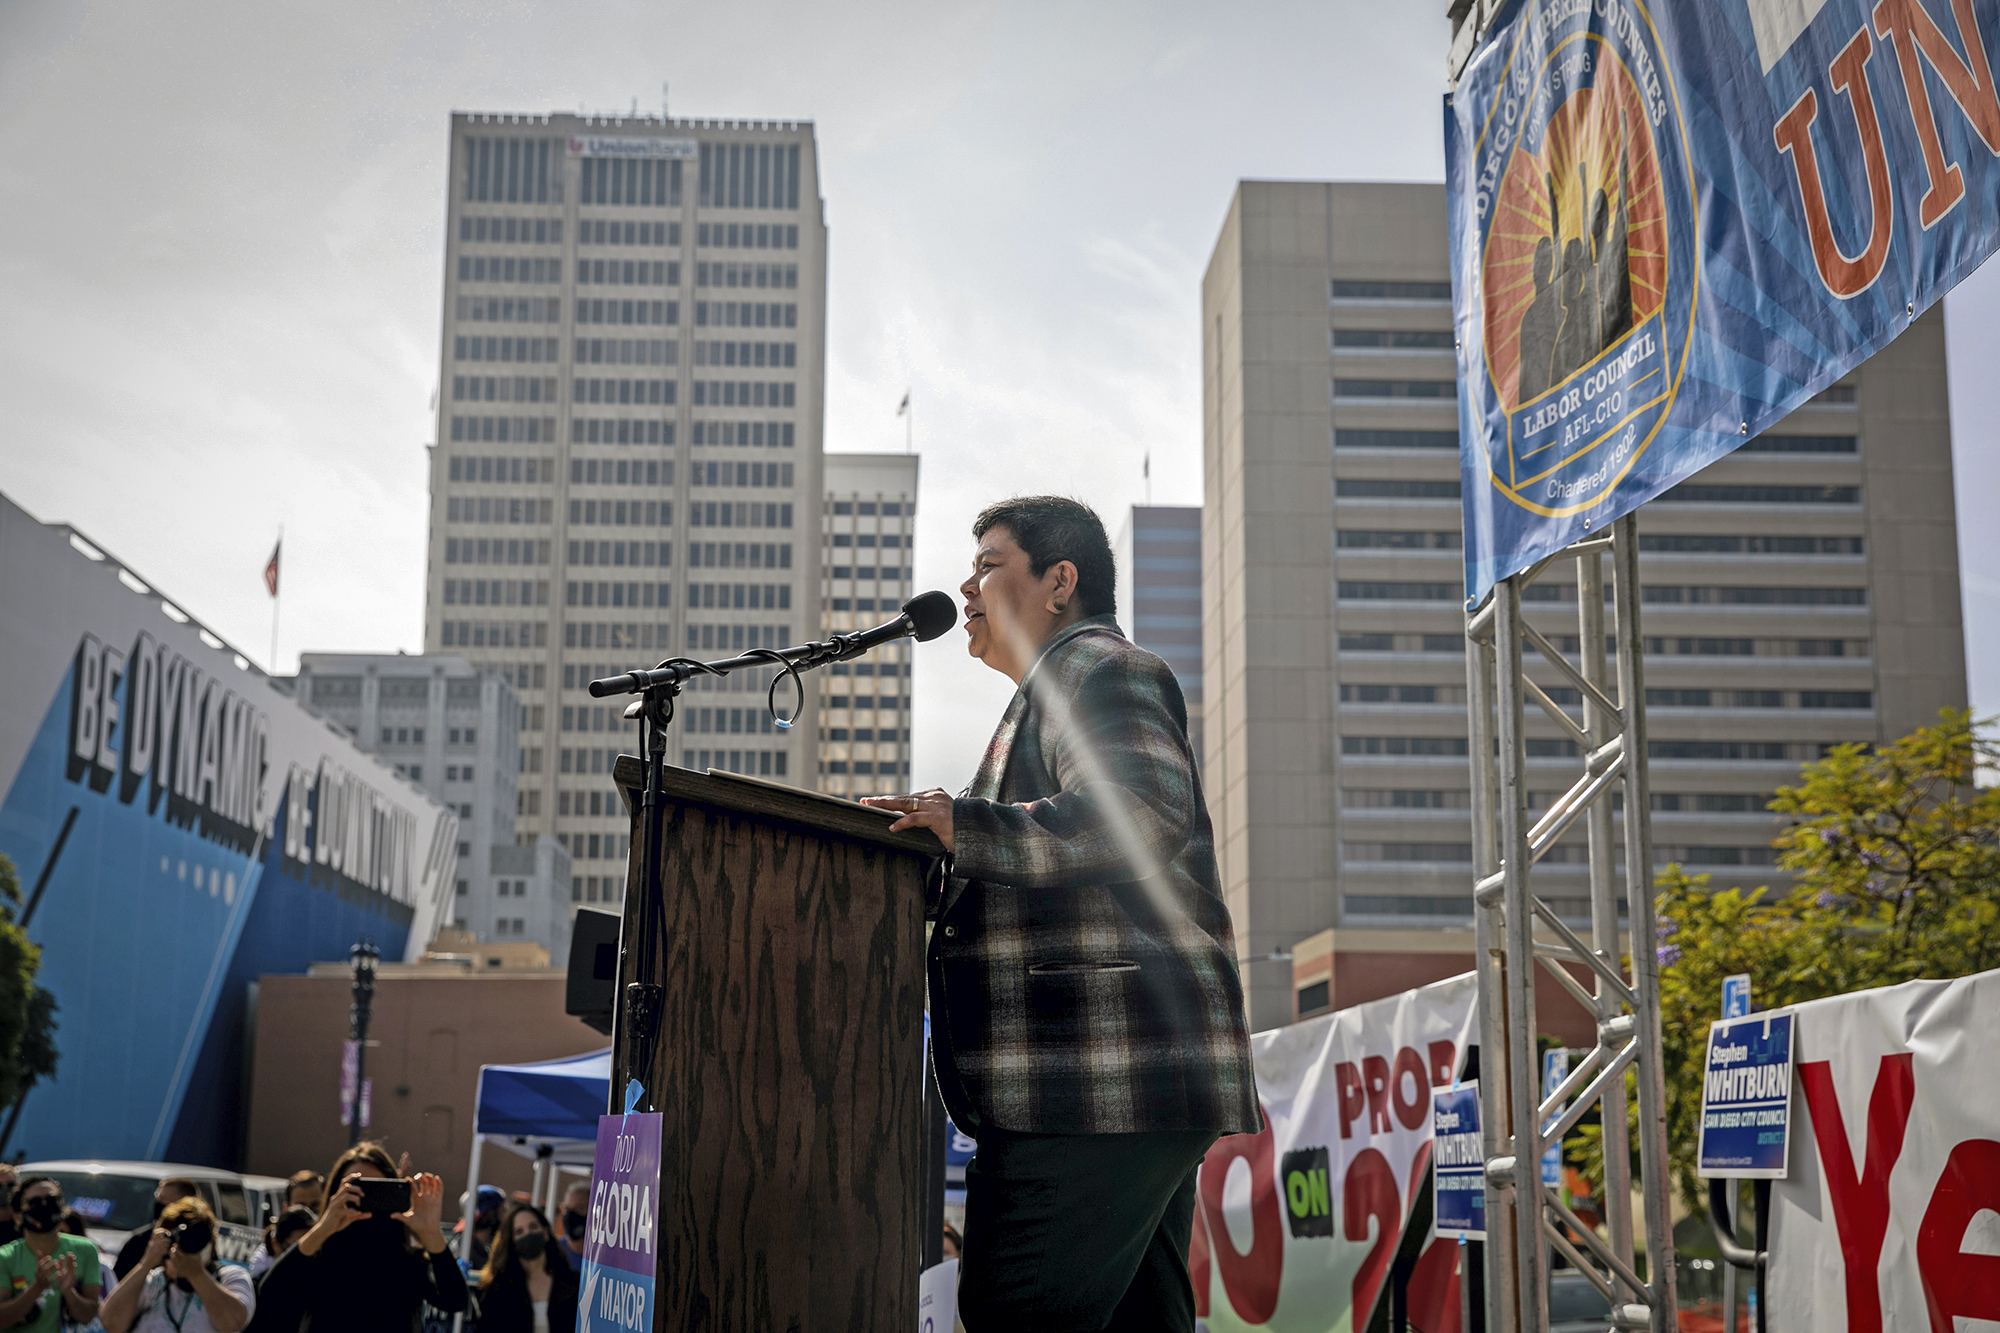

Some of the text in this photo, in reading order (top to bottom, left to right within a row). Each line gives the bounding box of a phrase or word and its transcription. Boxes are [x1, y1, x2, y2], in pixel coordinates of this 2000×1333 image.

[1552, 51, 1592, 91] STRONG
[1475, 98, 1518, 220] DIEGO
[1523, 332, 1656, 439] LABOR COUNCIL
[1563, 390, 1622, 447] AFL-CIO
[1546, 423, 1637, 499] Chartered 1902
[75, 631, 125, 773] BE
[1708, 1062, 1788, 1103] WHITBURN
[1711, 1043, 1748, 1068] Stephen
[1704, 1109, 1785, 1129] SAN DIEGO CITY COUNCIL
[612, 1135, 636, 1173] TODD
[591, 1179, 651, 1255] GLORIA
[1286, 1168, 1330, 1219] ON
[600, 1276, 646, 1333] MAYOR
